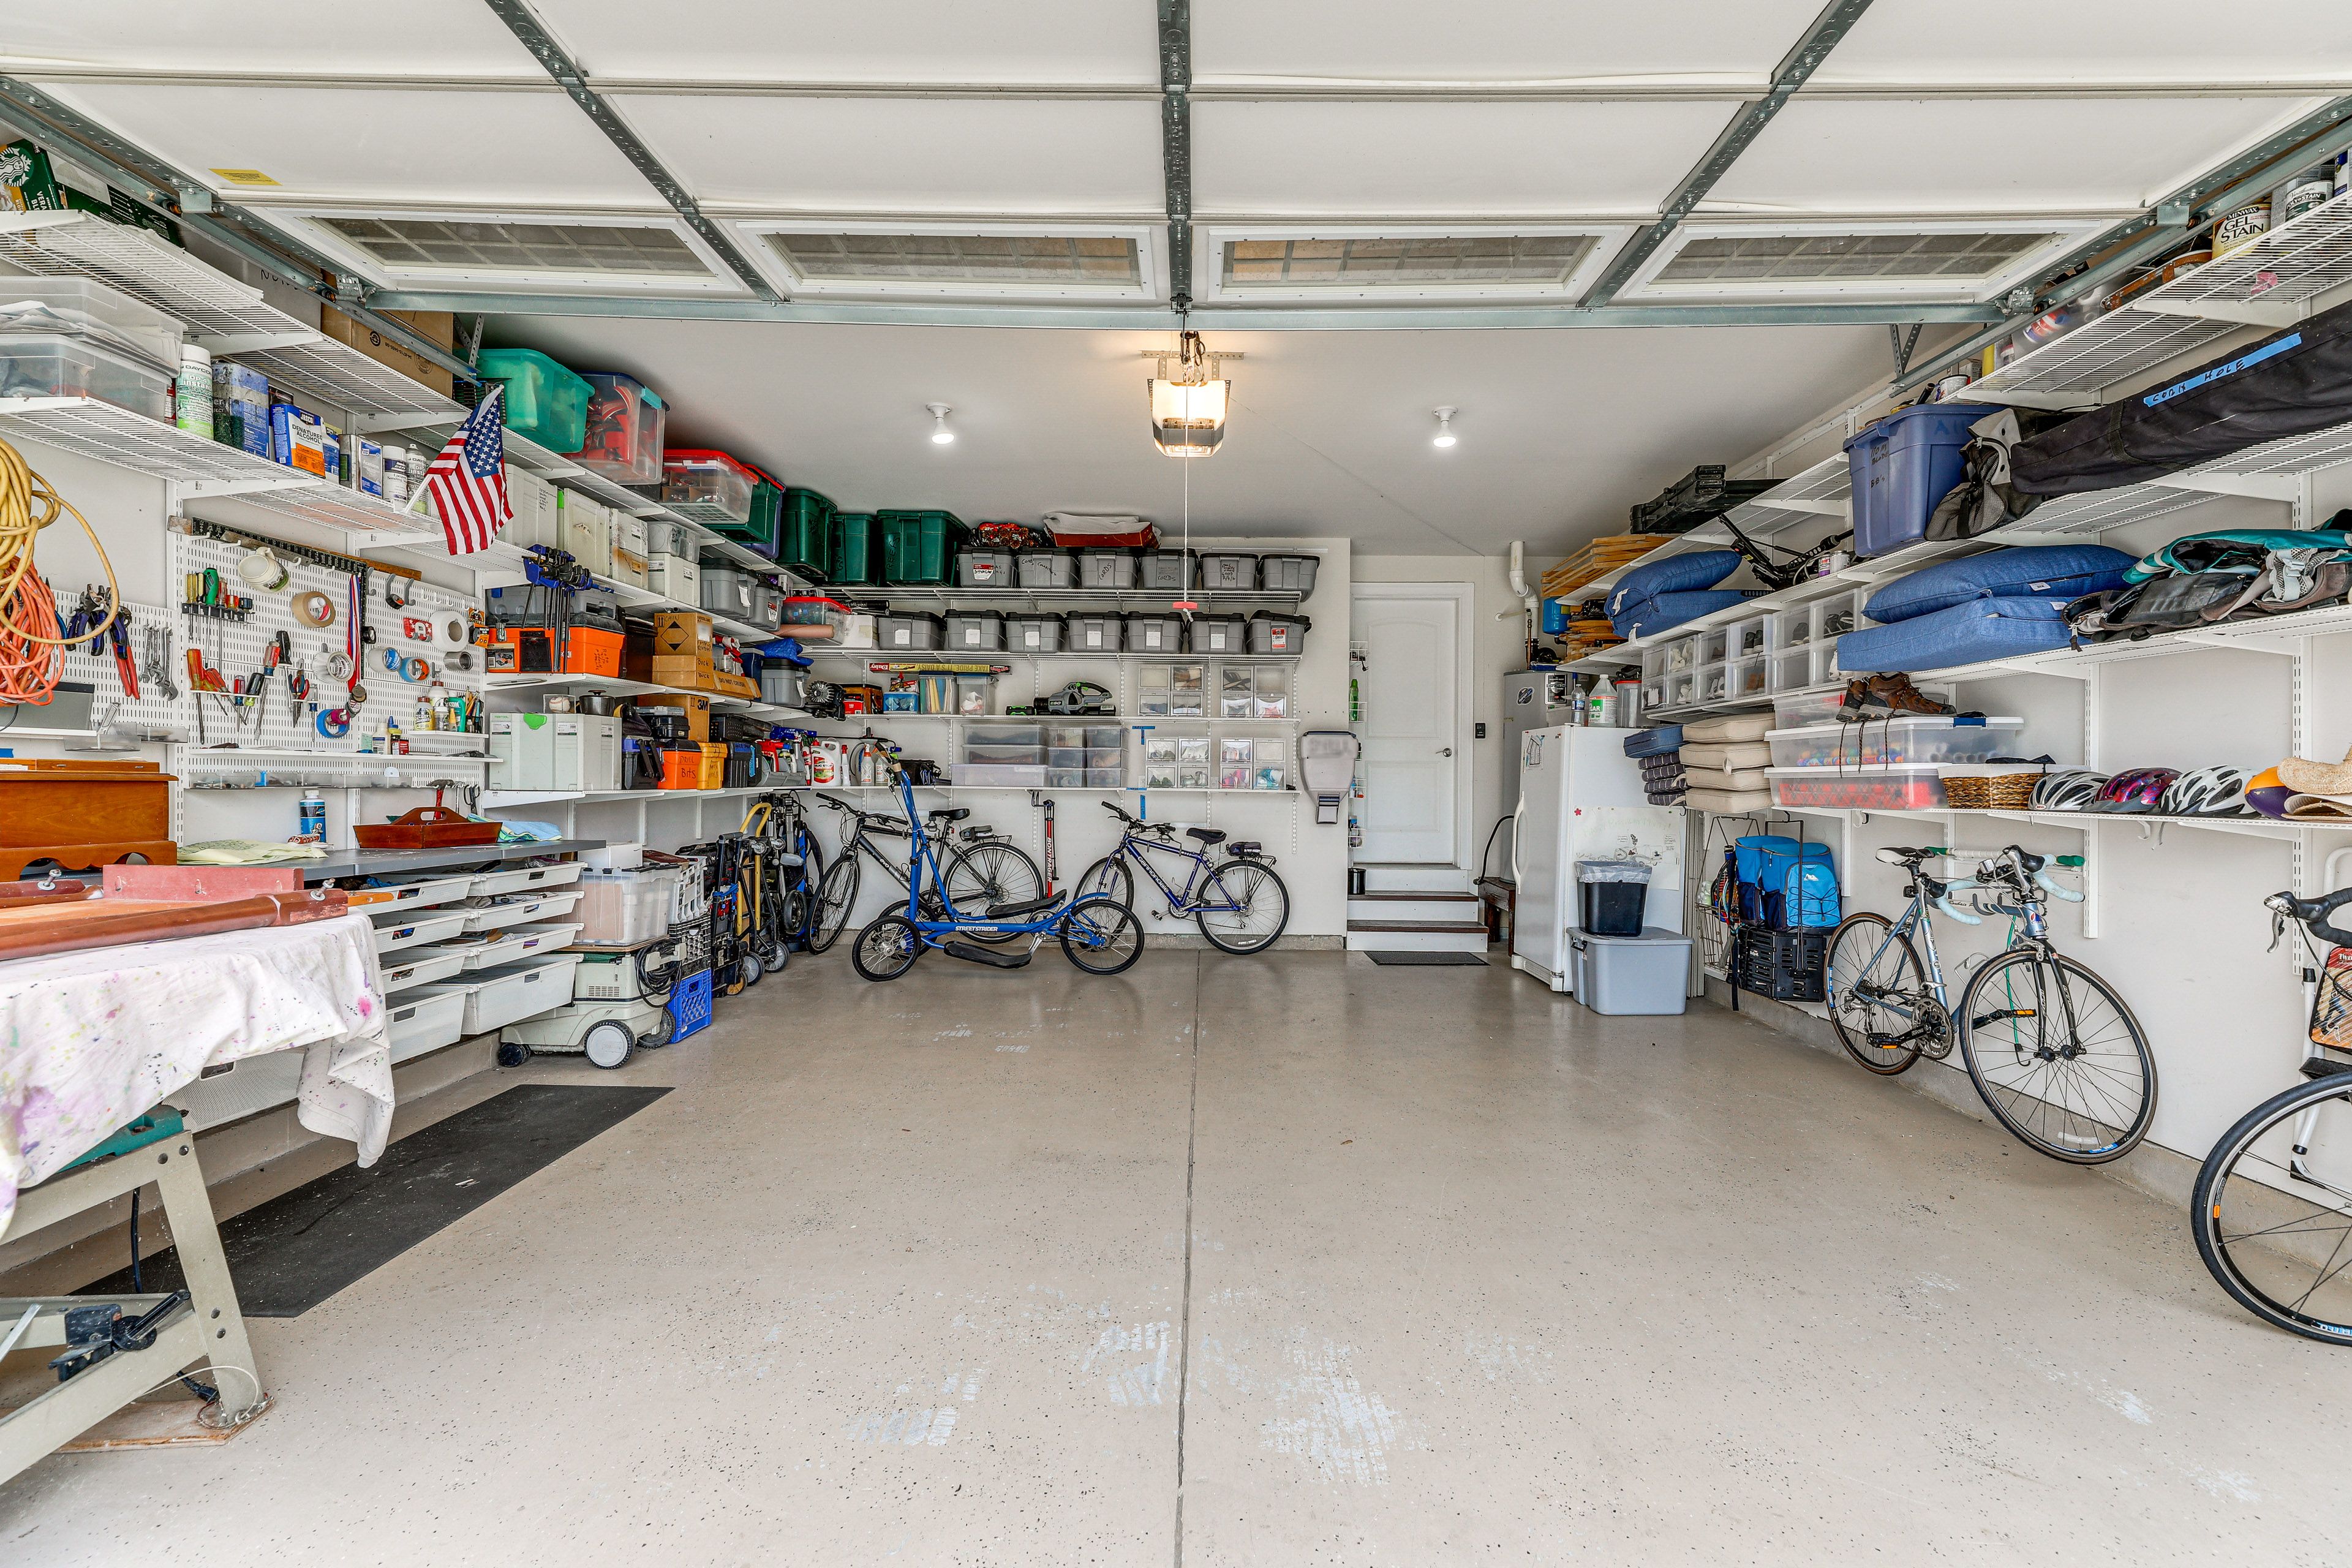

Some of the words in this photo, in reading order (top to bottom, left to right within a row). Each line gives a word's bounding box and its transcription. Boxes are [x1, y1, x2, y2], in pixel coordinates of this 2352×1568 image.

[2228, 208, 2258, 220] MINWAX
[2225, 216, 2254, 232] GEL
[2221, 223, 2264, 243] STAIN
[2205, 359, 2245, 382] HOLE
[183, 378, 212, 391] instant
[300, 413, 313, 424] JASCO
[292, 424, 323, 440] DENATURED
[296, 431, 321, 444] ALCOHOL
[697, 699, 708, 711] 3M
[680, 755, 695, 764] DRILL
[1137, 856, 1169, 893] cannondale
